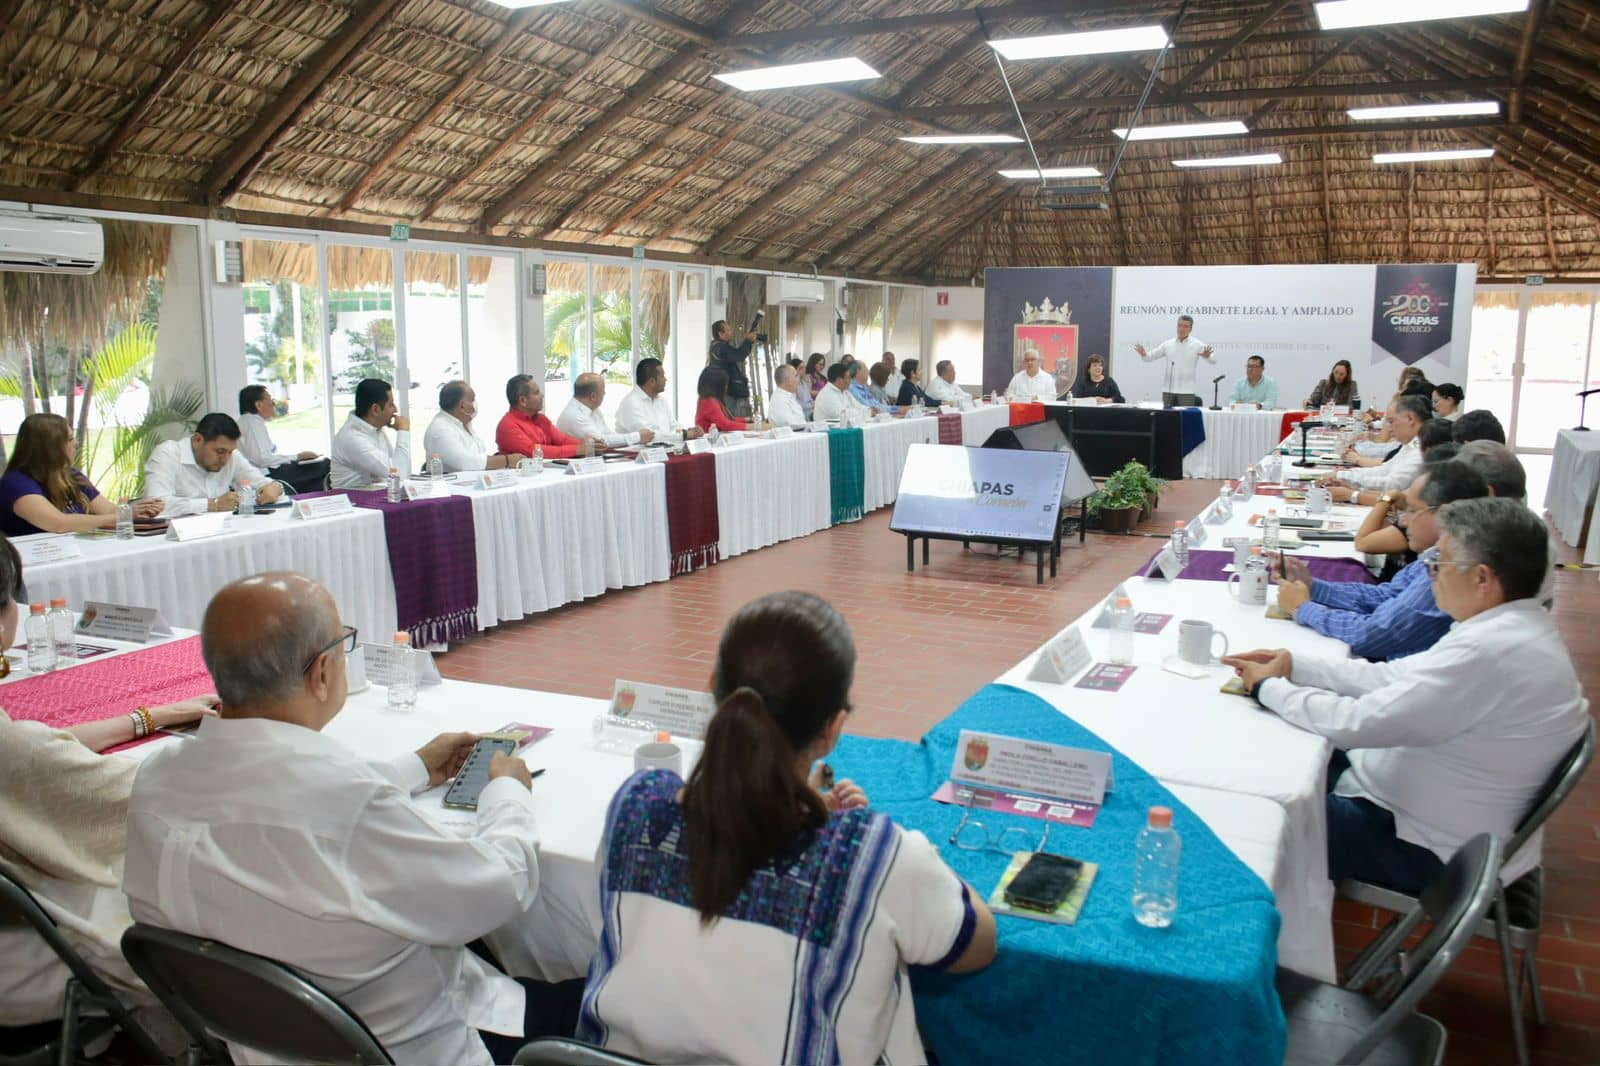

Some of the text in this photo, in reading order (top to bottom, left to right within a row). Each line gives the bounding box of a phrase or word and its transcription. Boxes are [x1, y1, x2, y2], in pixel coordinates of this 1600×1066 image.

[1120, 304, 1354, 316] REUNIÓN DE GABINETE LEGAL Y AMPLIADO
[1390, 315, 1440, 326] CHIAPAS
